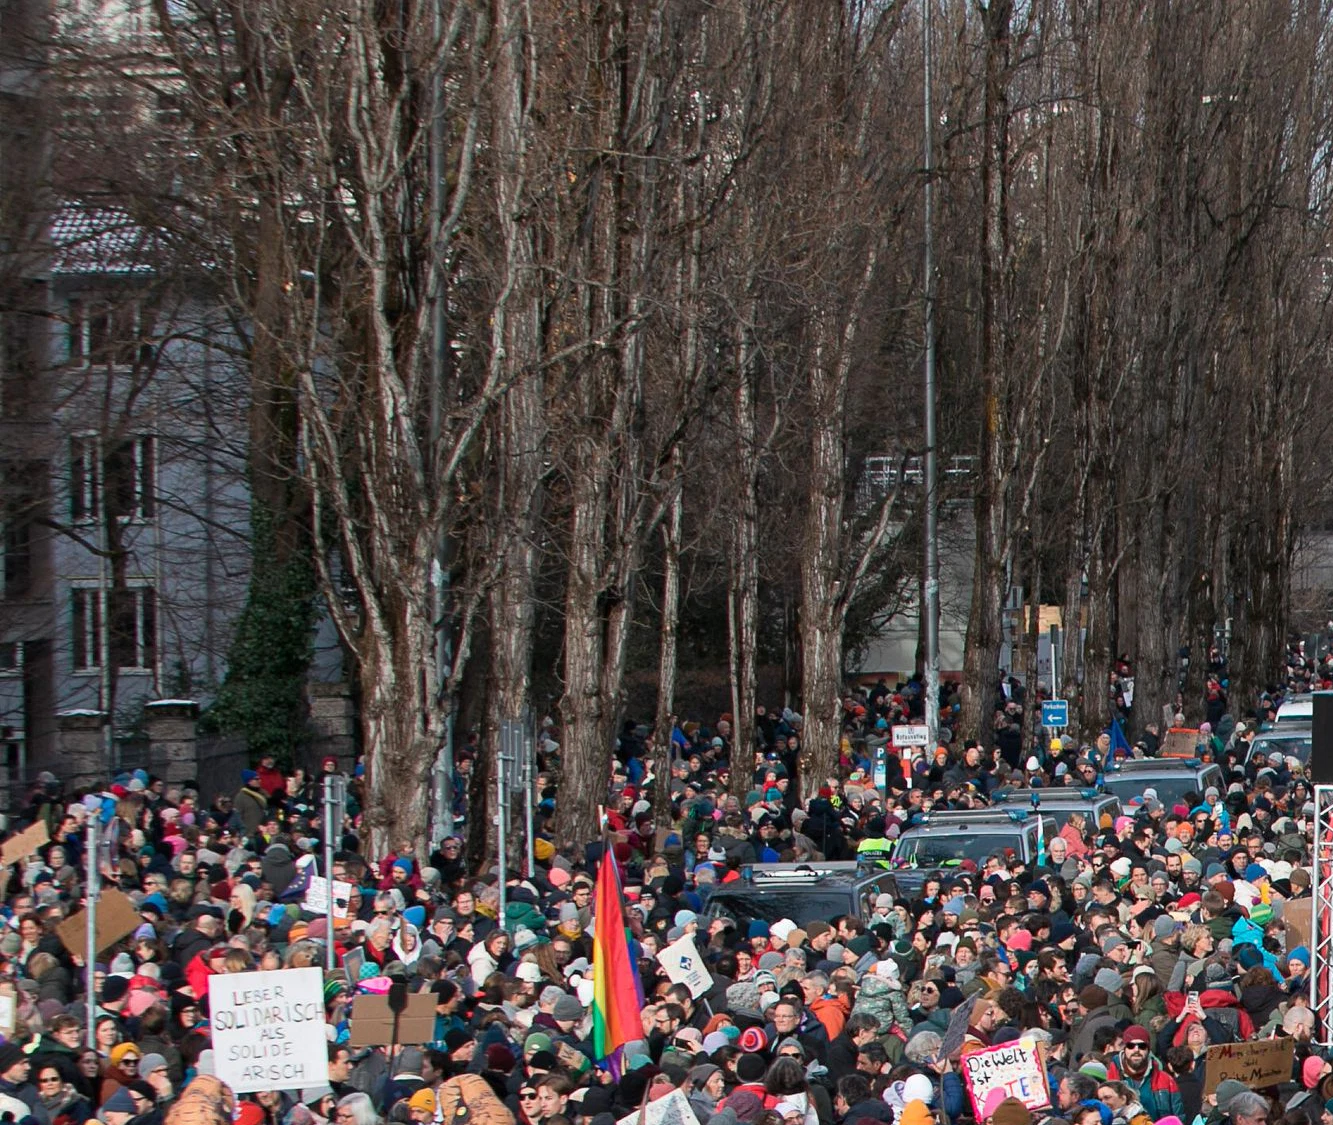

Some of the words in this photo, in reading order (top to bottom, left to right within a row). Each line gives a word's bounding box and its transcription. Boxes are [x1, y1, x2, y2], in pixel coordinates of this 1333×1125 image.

[215, 1001, 325, 1031] SOLIDARISCH
[260, 1026, 286, 1042] ALS
[228, 1041, 294, 1061] SOLIDE
[241, 1062, 305, 1081] ARISCH
